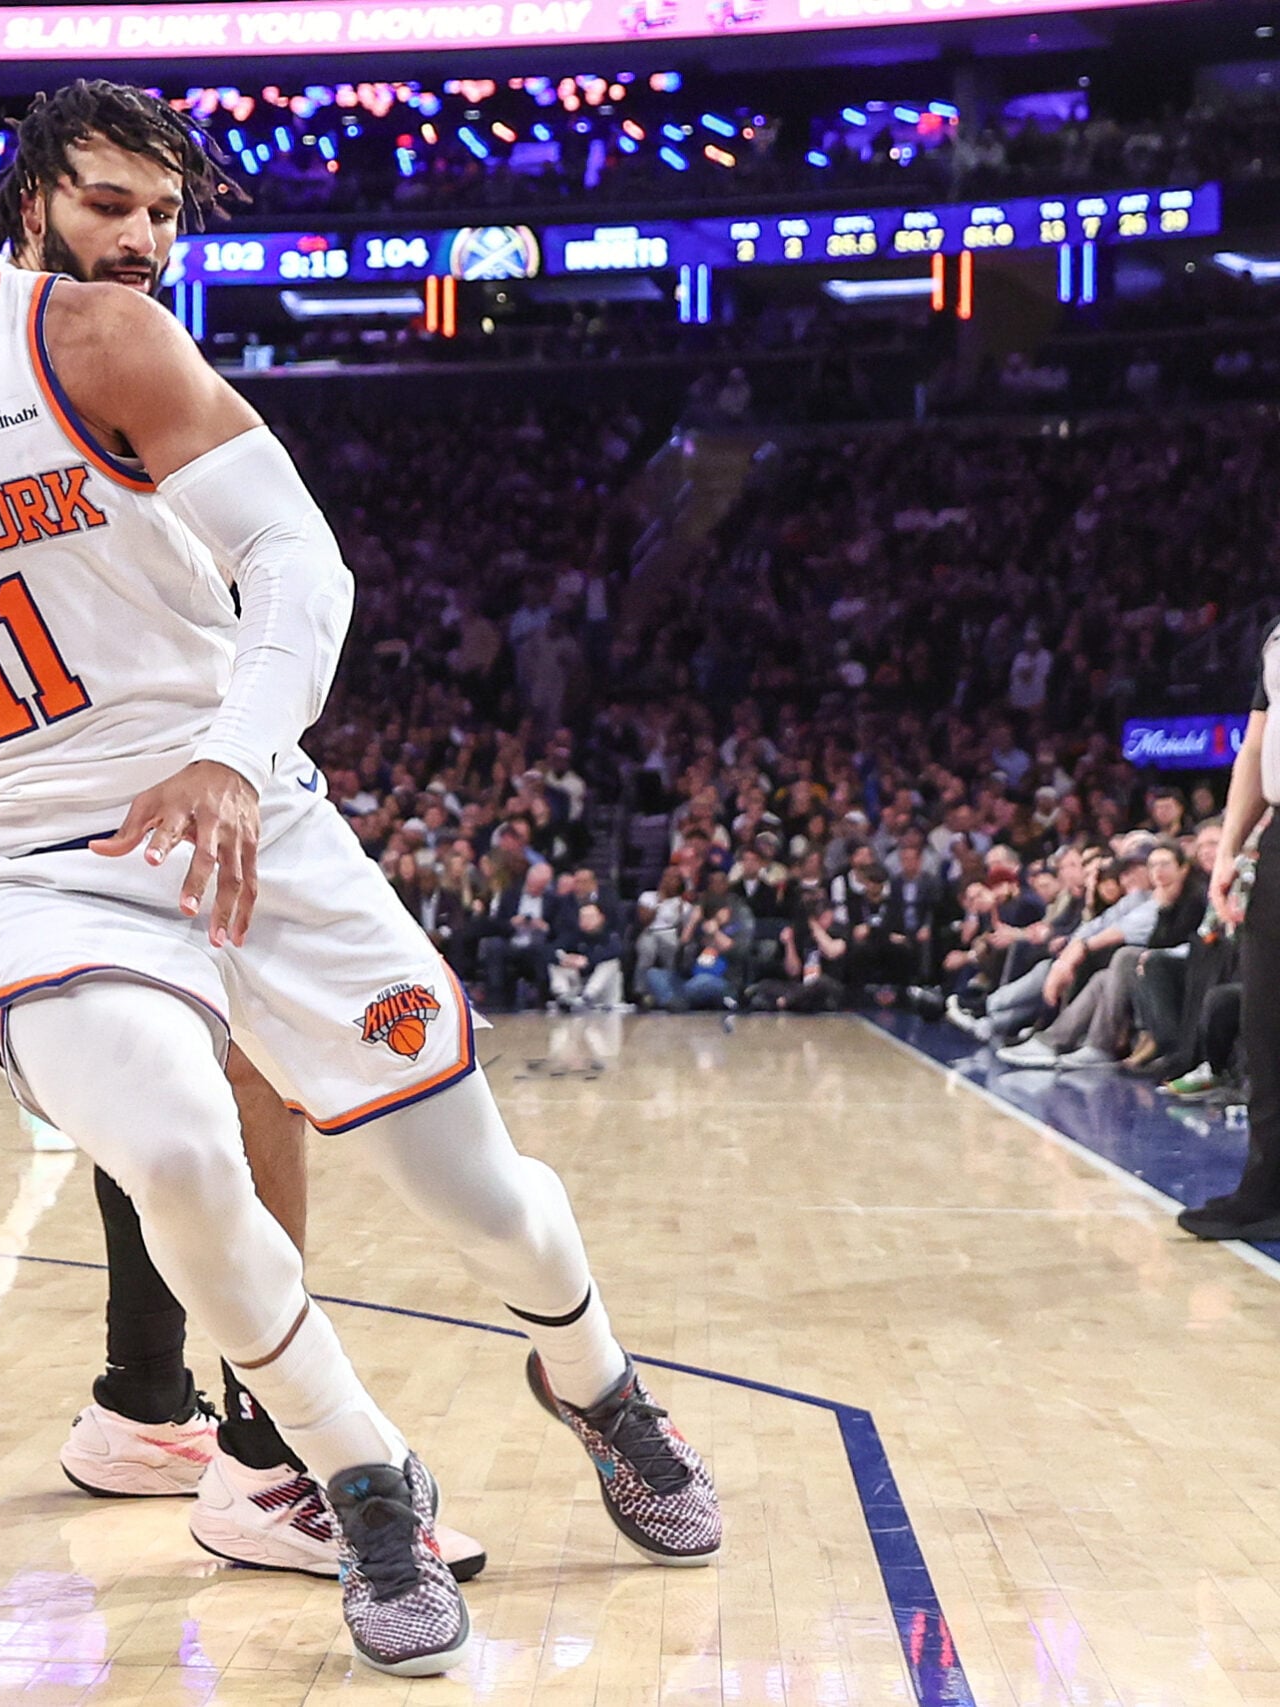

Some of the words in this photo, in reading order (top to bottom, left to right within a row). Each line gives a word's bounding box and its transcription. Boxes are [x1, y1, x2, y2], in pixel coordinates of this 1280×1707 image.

[3, 17, 112, 48] SLAM
[118, 14, 231, 47] DUNK
[237, 11, 342, 43] YOUR
[348, 5, 503, 41] MOVING
[510, 1, 592, 34] DAY
[203, 241, 265, 271] 102
[366, 237, 429, 268] 104
[361, 984, 441, 1042] KNICKS
